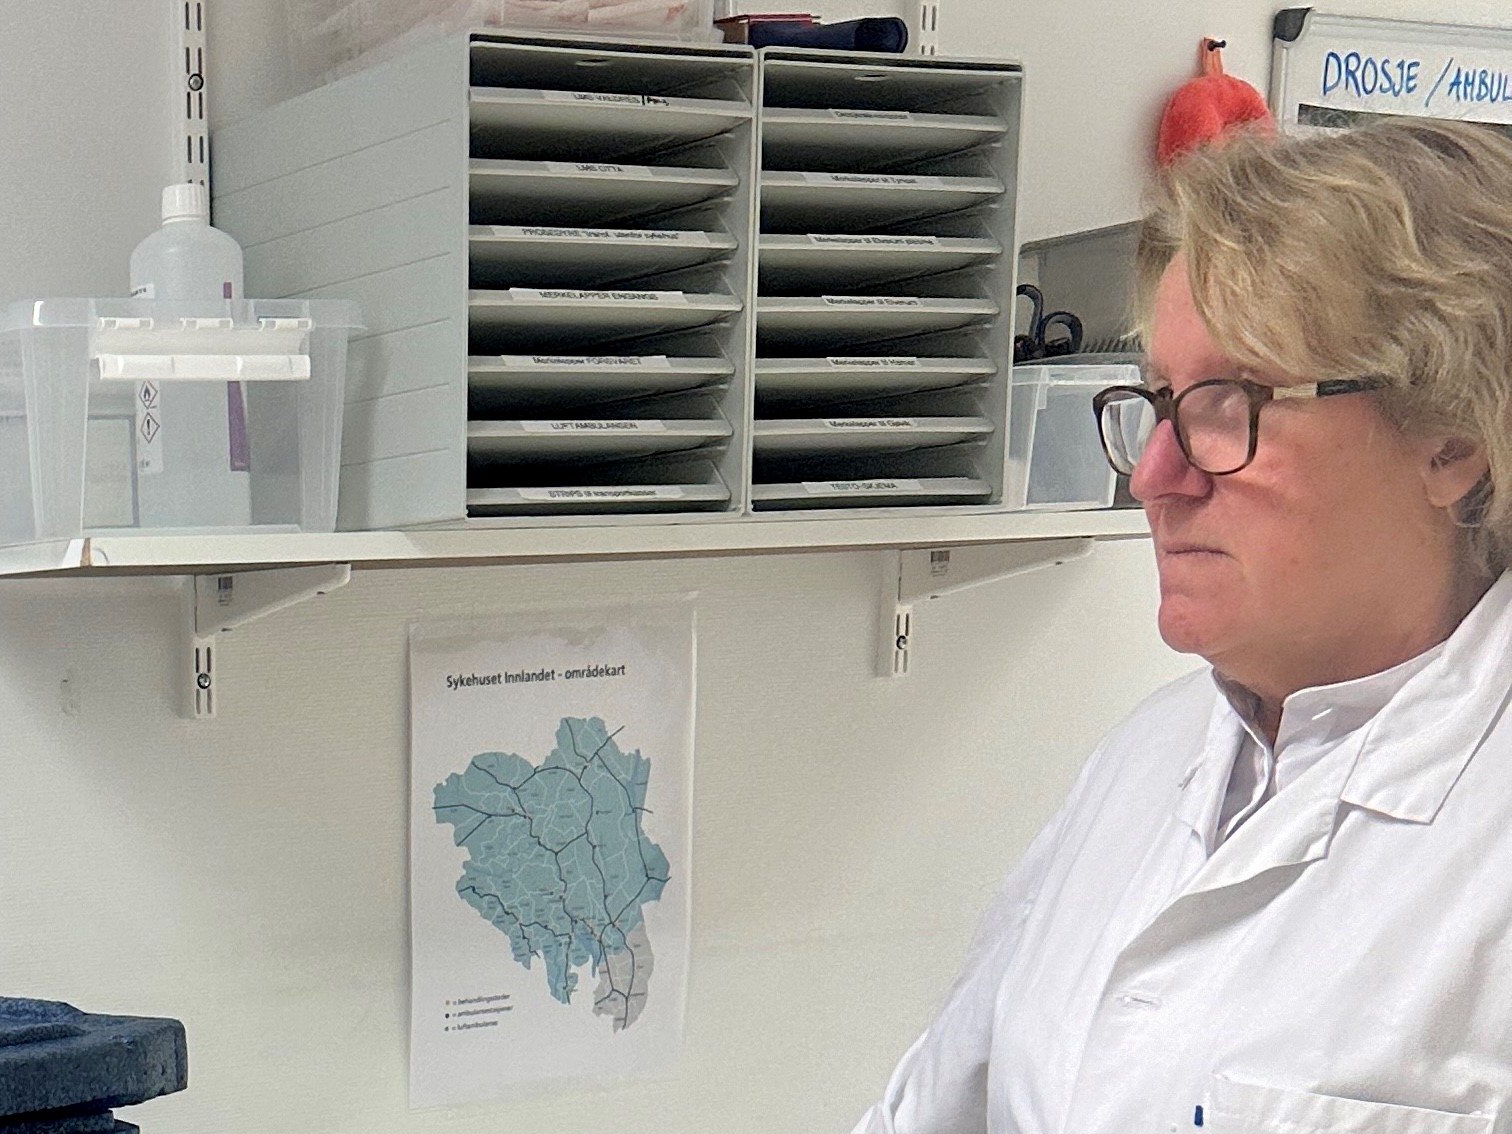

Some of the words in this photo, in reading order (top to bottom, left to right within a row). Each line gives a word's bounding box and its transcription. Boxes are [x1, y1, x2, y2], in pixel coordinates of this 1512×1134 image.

[1322, 51, 1420, 97] DROSJE
[446, 671, 502, 691] Sykehuset
[504, 668, 555, 685] Innlandet
[564, 664, 626, 681] områdekart
